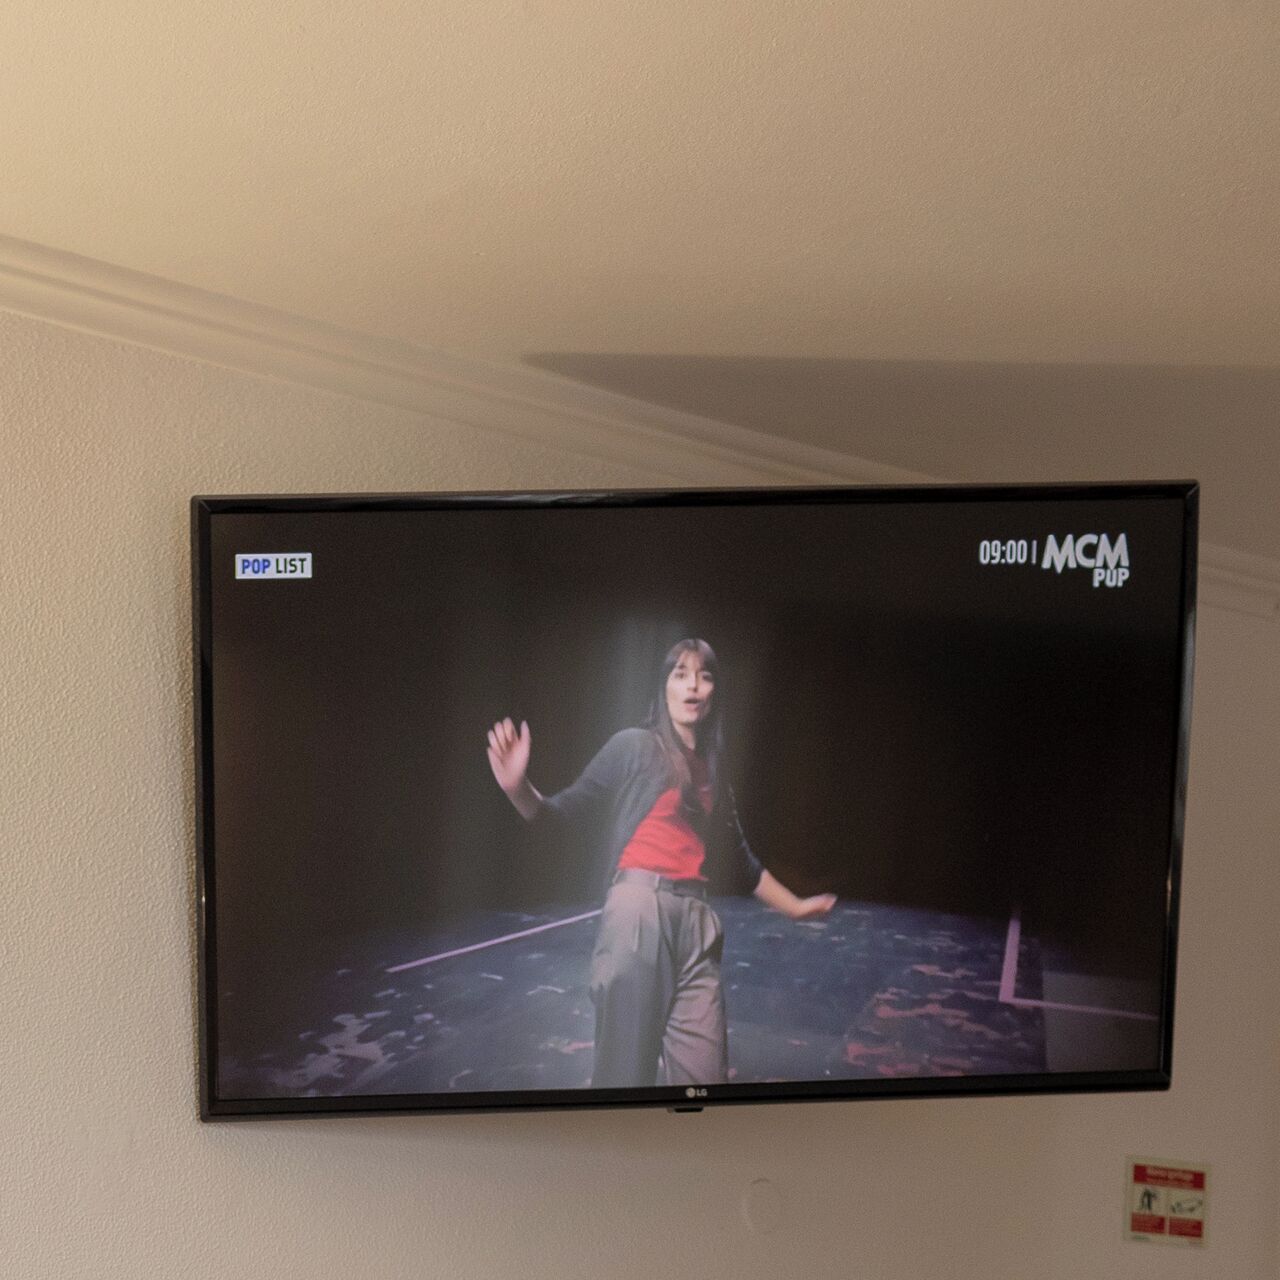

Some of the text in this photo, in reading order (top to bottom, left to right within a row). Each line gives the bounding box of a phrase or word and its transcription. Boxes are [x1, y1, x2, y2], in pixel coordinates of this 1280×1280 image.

[979, 533, 1130, 574] 09:00 MCM
[241, 557, 307, 574] POP LIST
[696, 1088, 708, 1097] LG
